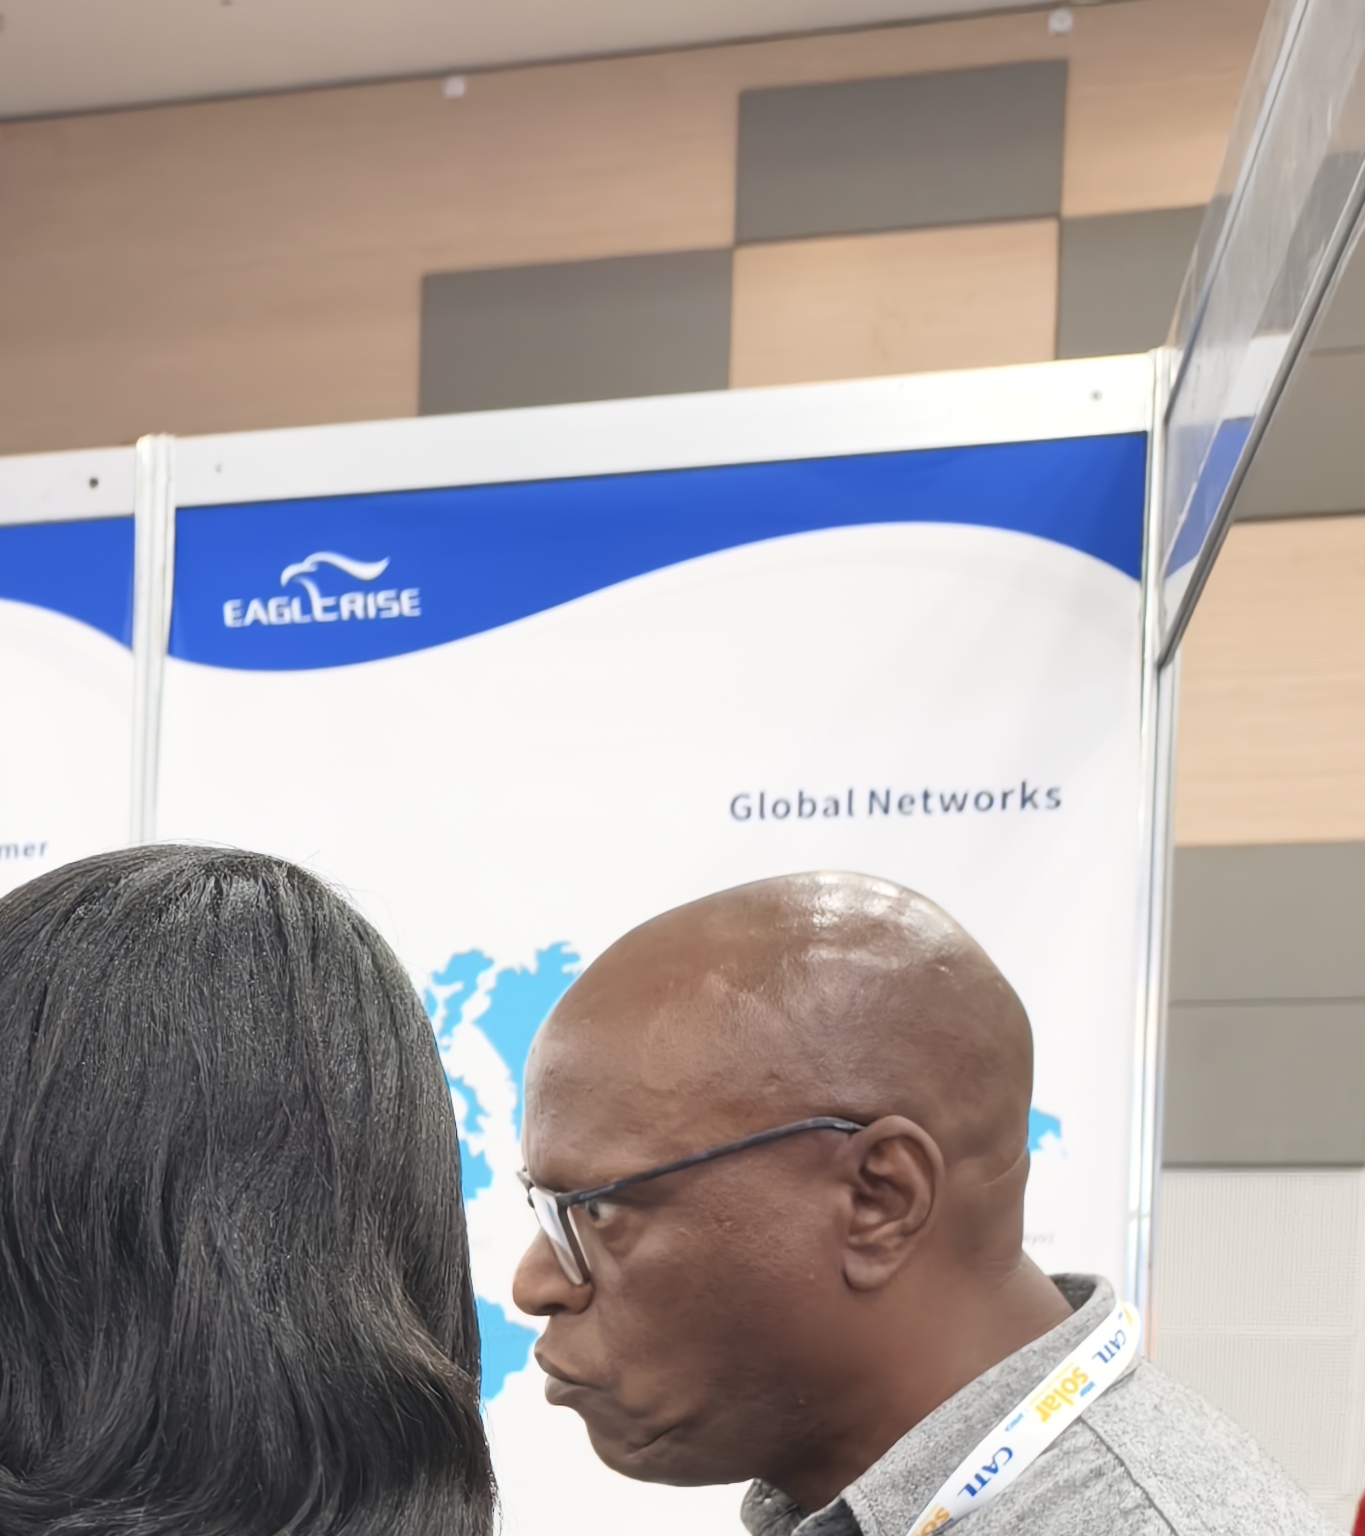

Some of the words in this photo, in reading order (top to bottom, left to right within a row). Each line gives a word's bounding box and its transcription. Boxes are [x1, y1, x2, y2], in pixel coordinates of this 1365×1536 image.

[224, 586, 422, 629] EAGLERISE
[728, 786, 856, 822] Global
[867, 780, 1063, 818] Networks
[1091, 1329, 1127, 1364] CATL
[1034, 1365, 1089, 1423] solar
[956, 1446, 1014, 1497] CATL
